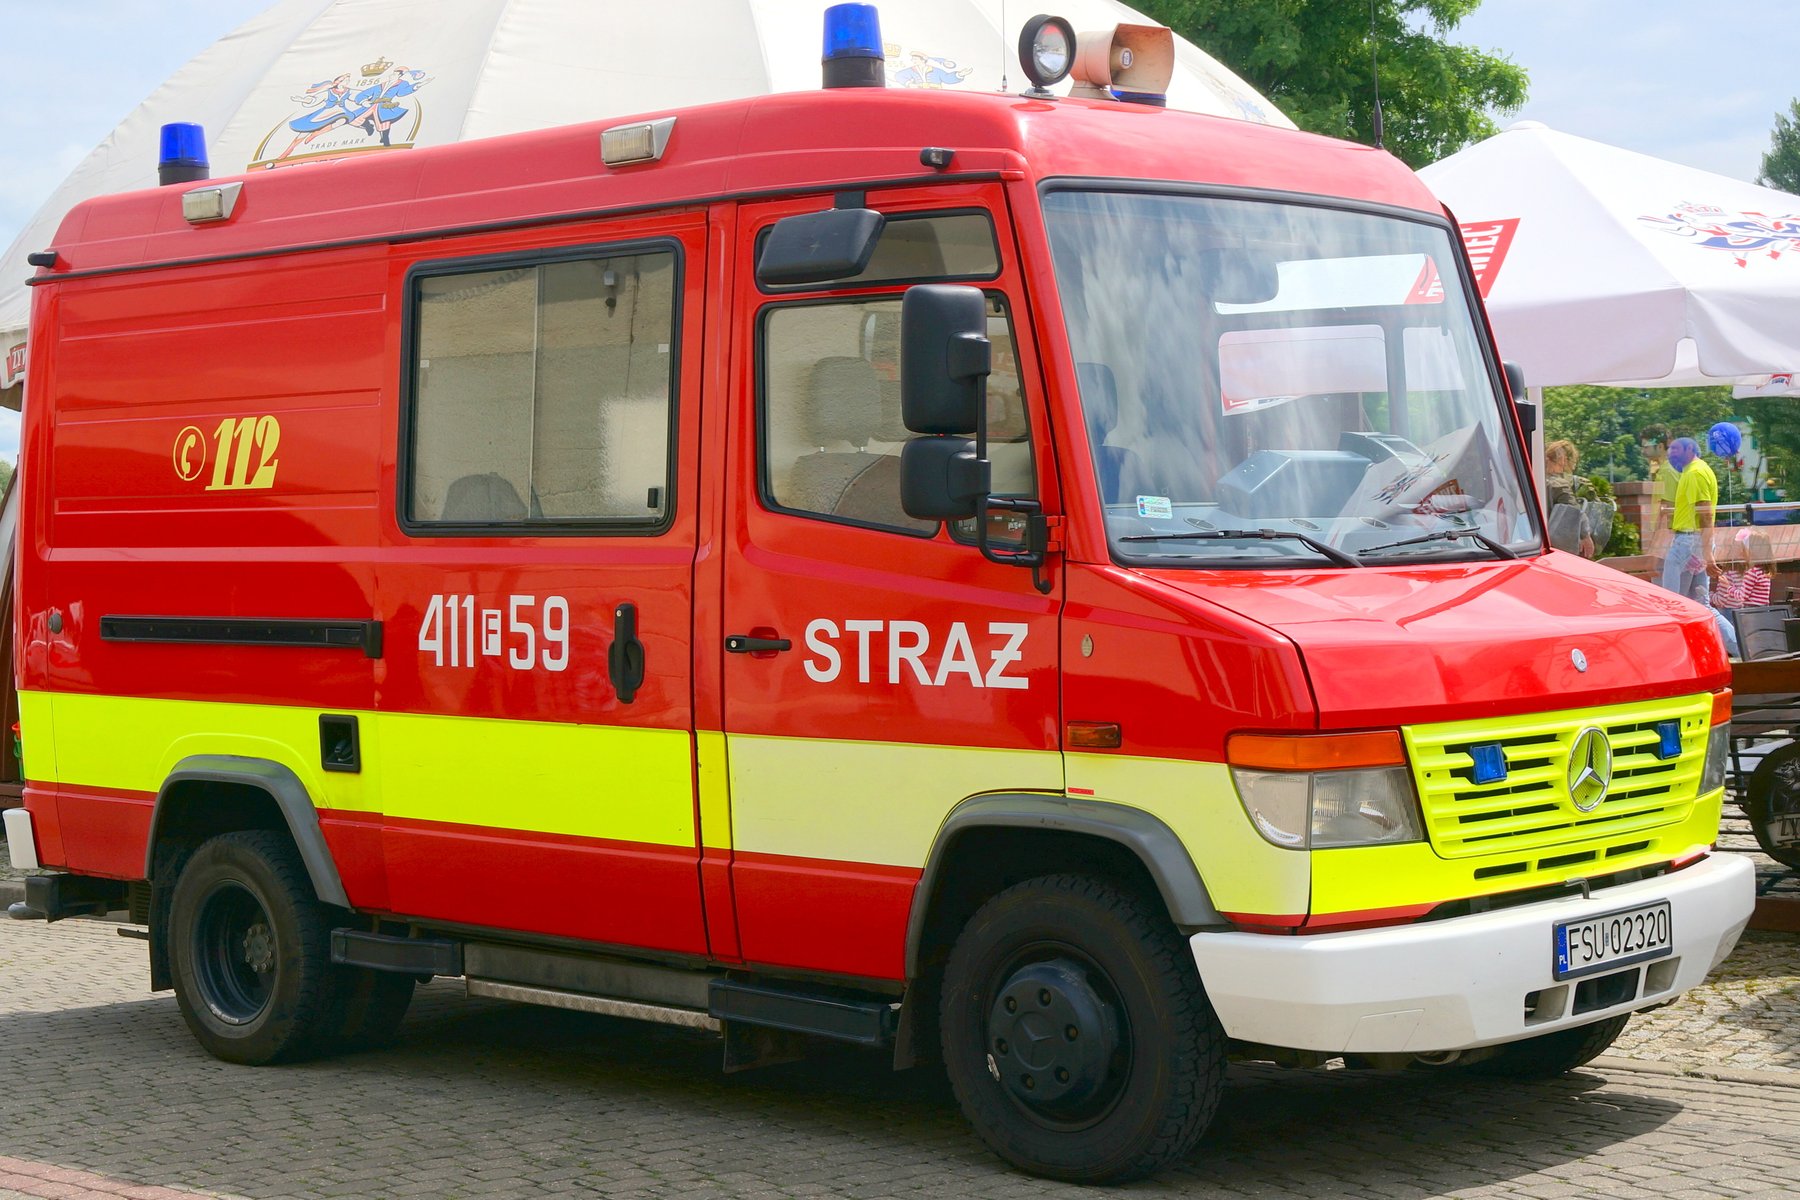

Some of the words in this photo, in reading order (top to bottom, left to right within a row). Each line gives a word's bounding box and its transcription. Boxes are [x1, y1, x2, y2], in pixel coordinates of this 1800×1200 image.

[355, 78, 381, 87] 1856
[310, 141, 338, 150] TRADE
[341, 138, 366, 146] MARK
[205, 415, 280, 491] 112
[1558, 954, 1568, 966] PL
